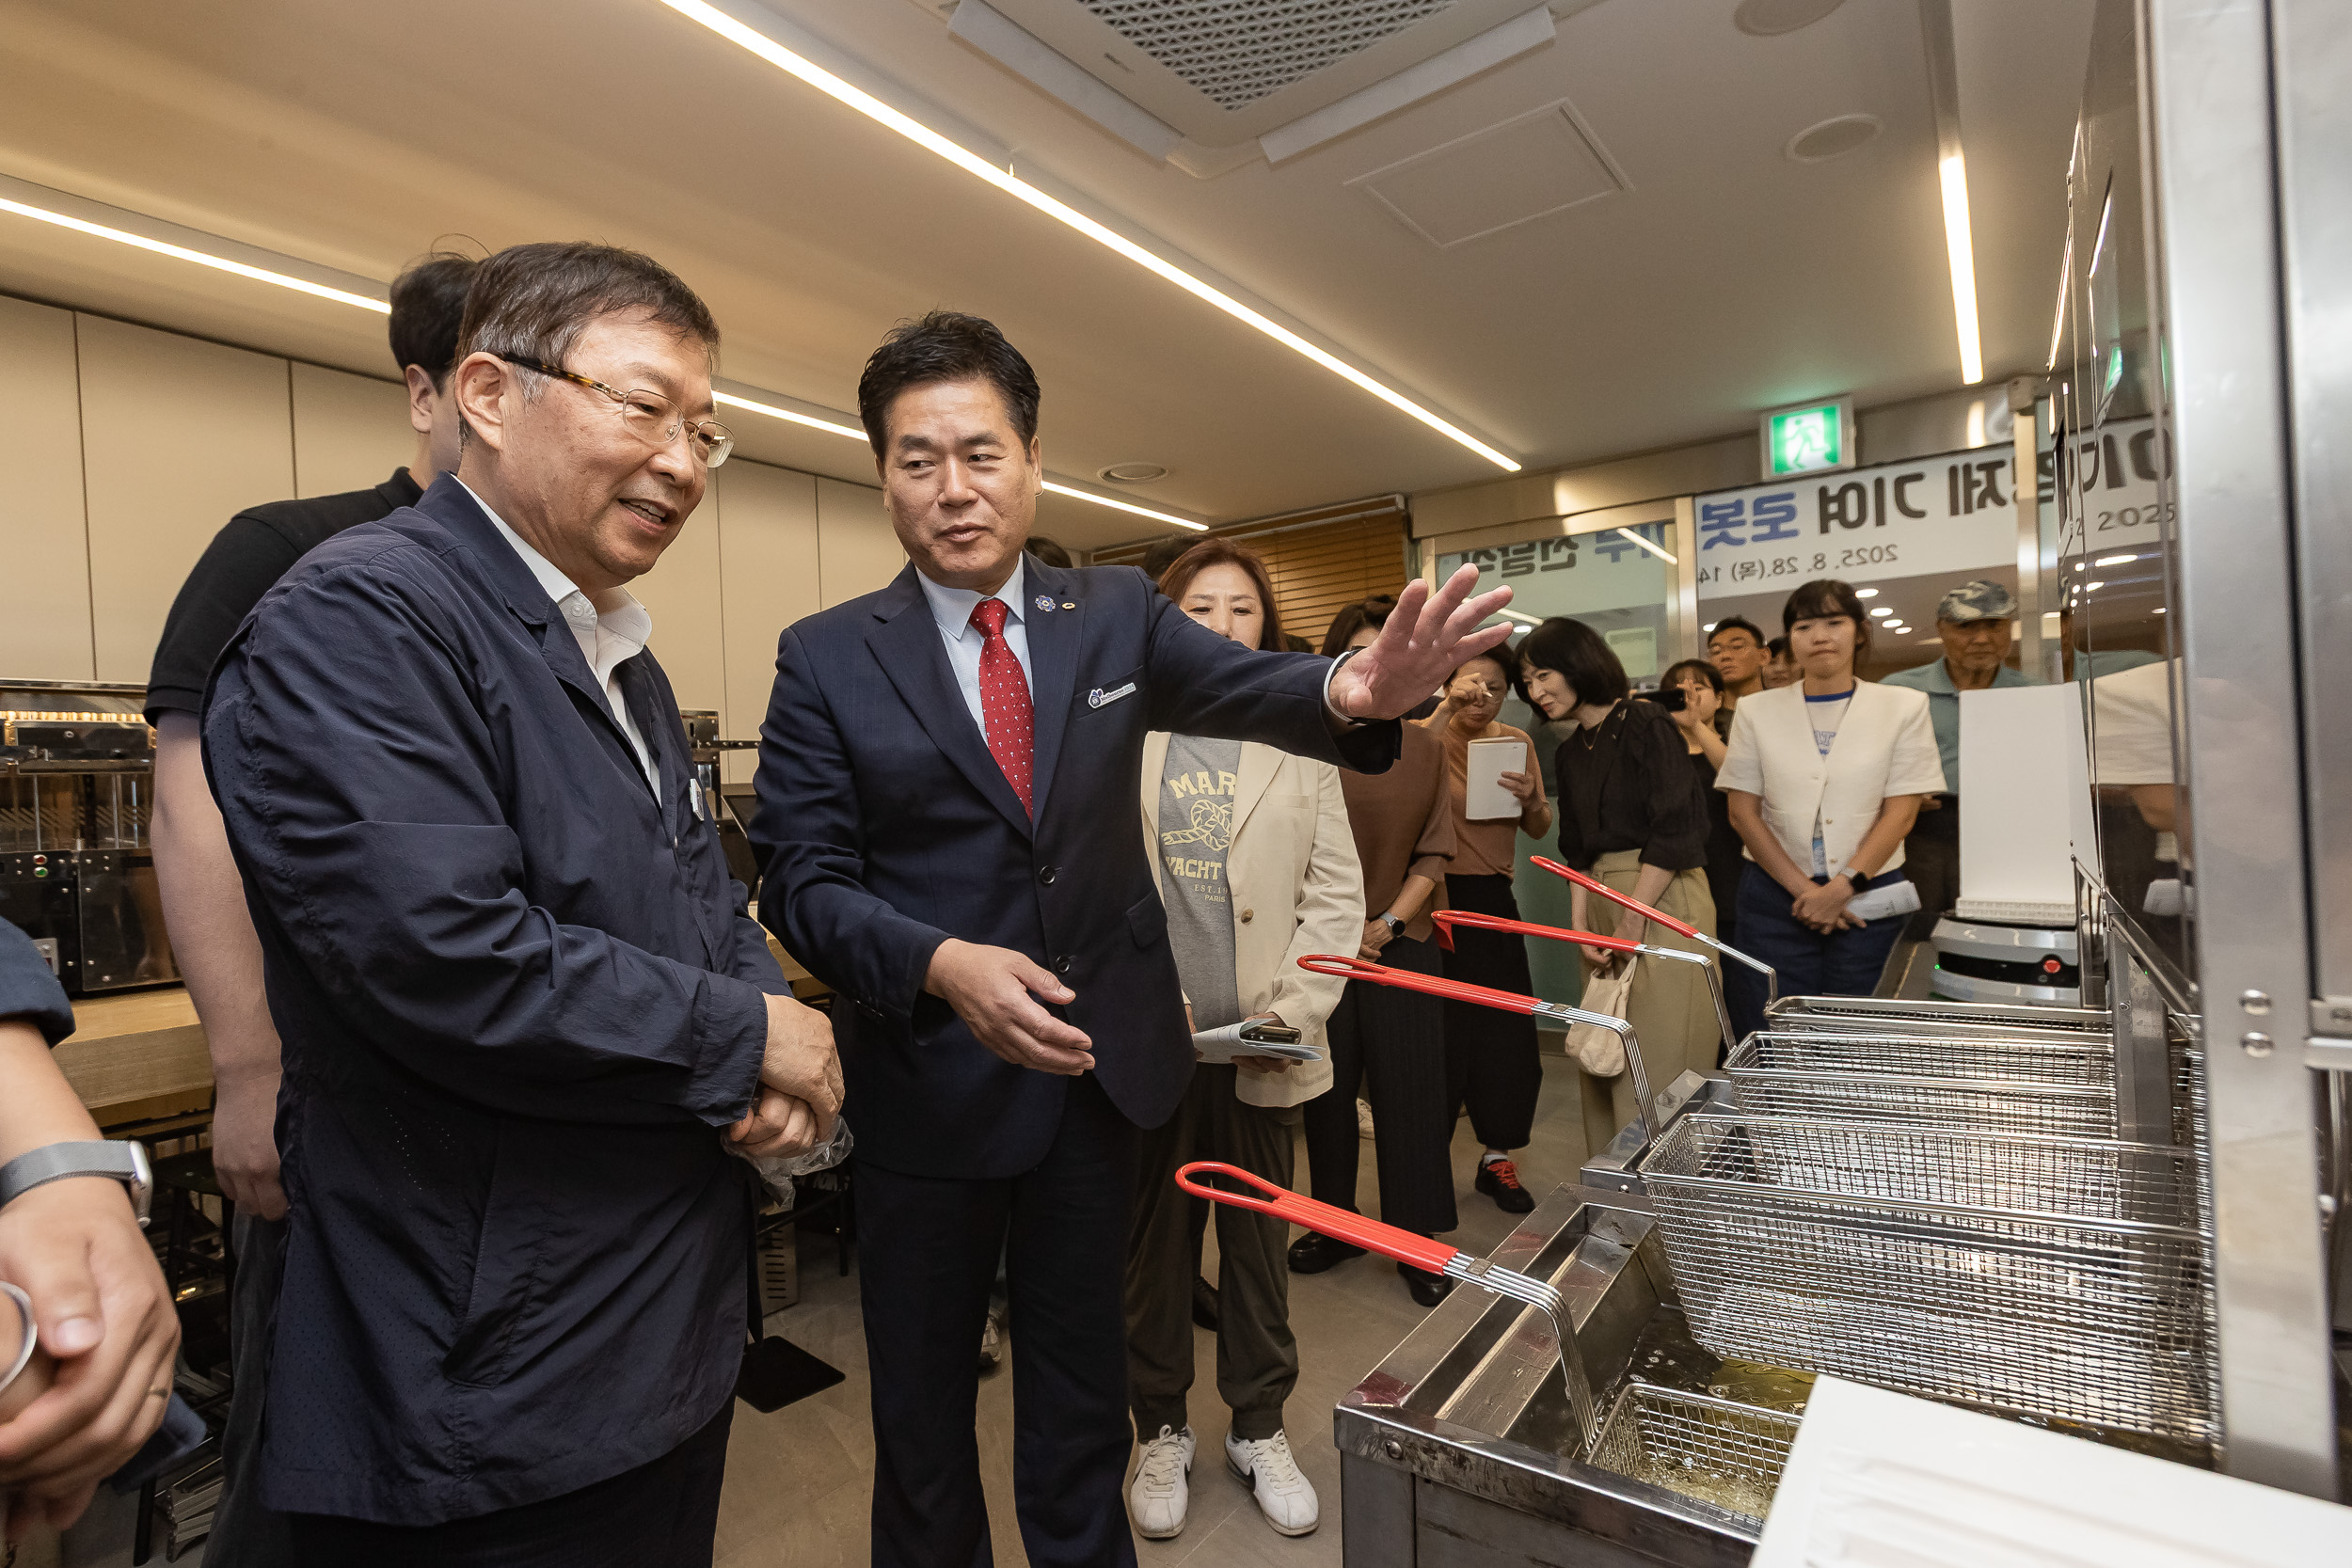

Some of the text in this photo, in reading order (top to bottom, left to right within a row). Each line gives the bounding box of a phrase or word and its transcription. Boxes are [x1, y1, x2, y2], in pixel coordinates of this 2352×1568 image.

[1168, 769, 1237, 800] MAR
[1165, 857, 1222, 880] YACHT
[1204, 895, 1226, 903] PARIS
